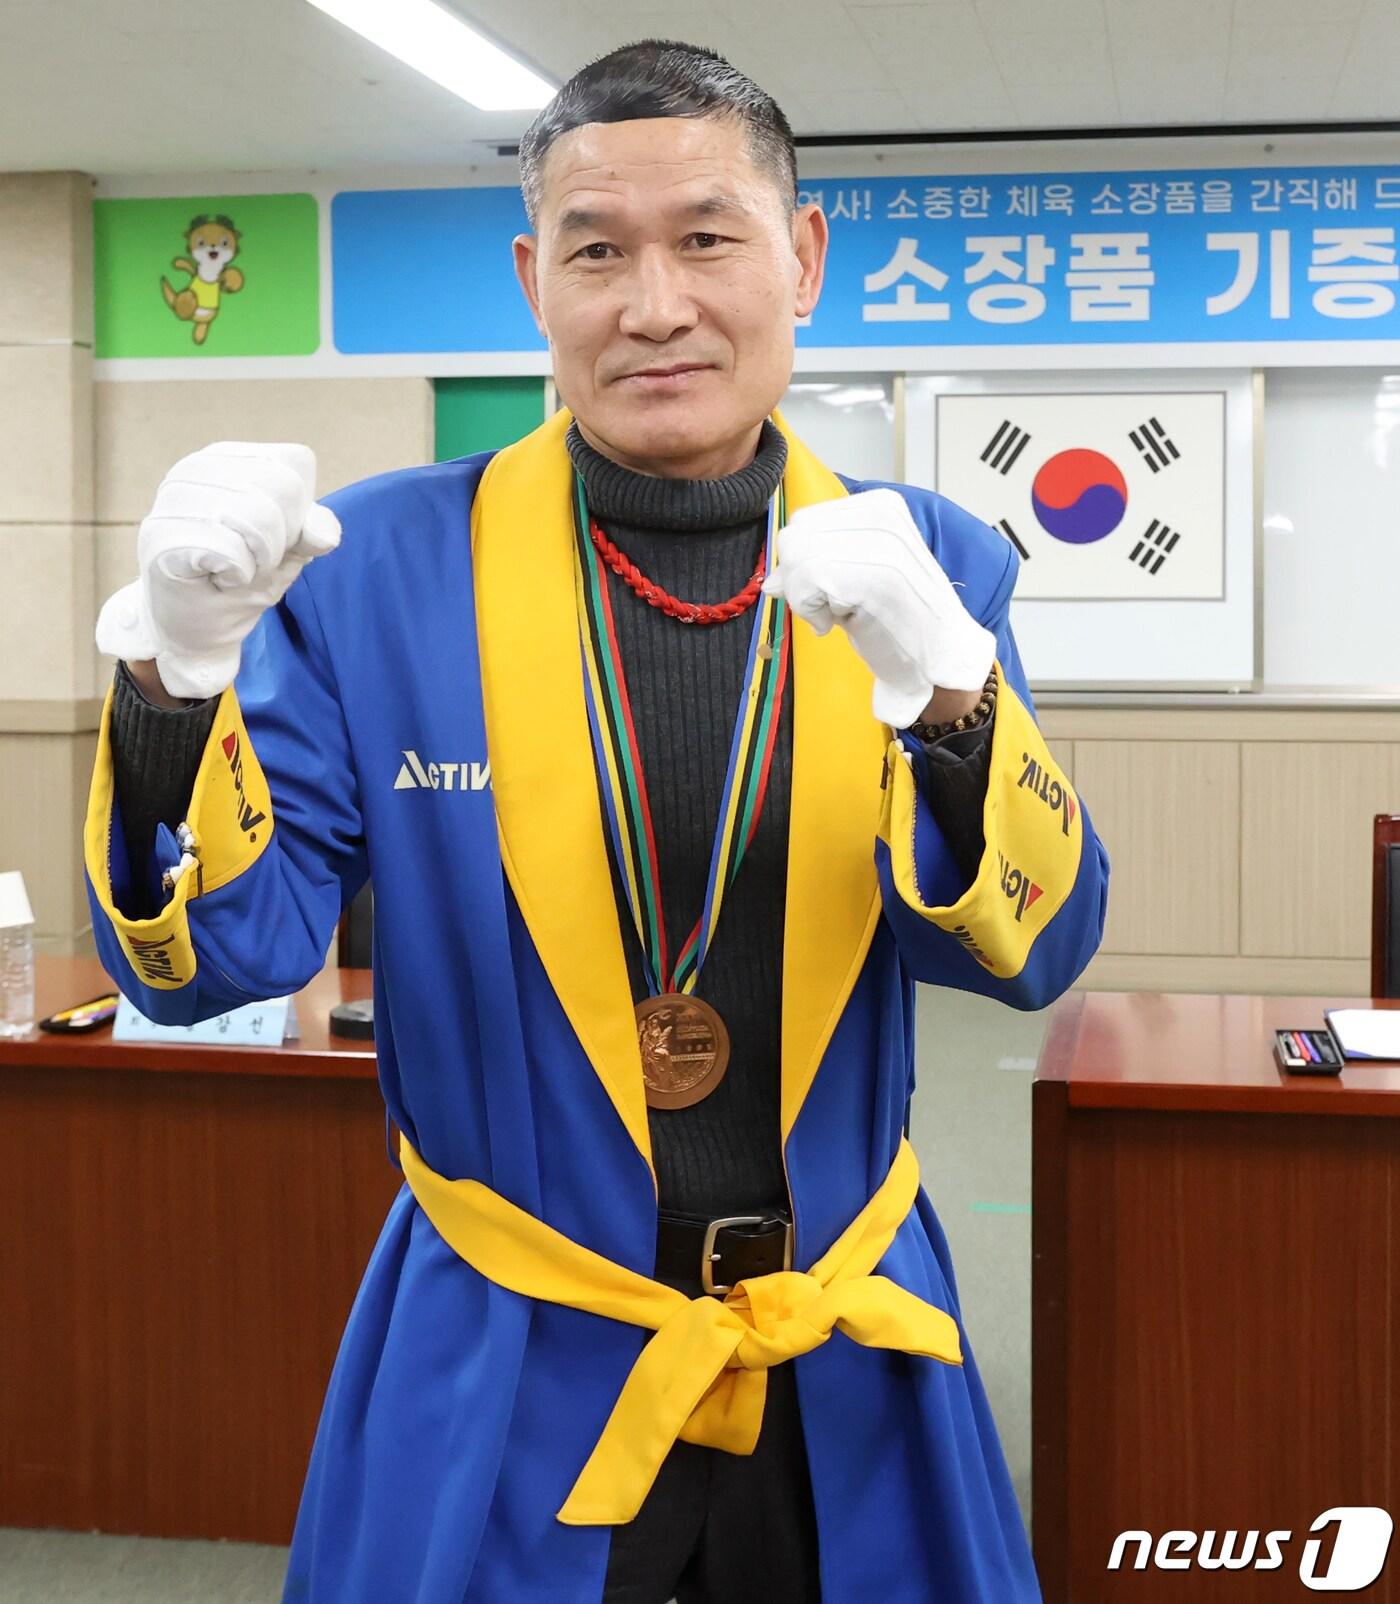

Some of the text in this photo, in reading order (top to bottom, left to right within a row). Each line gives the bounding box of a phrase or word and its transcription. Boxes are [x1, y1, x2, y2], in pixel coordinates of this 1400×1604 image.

[887, 186, 992, 219] 소중한
[1006, 184, 1075, 217] 체육
[1090, 180, 1233, 215] 소장품을
[1251, 178, 1358, 212] 간직해
[862, 227, 1399, 324] 소장품 기증
